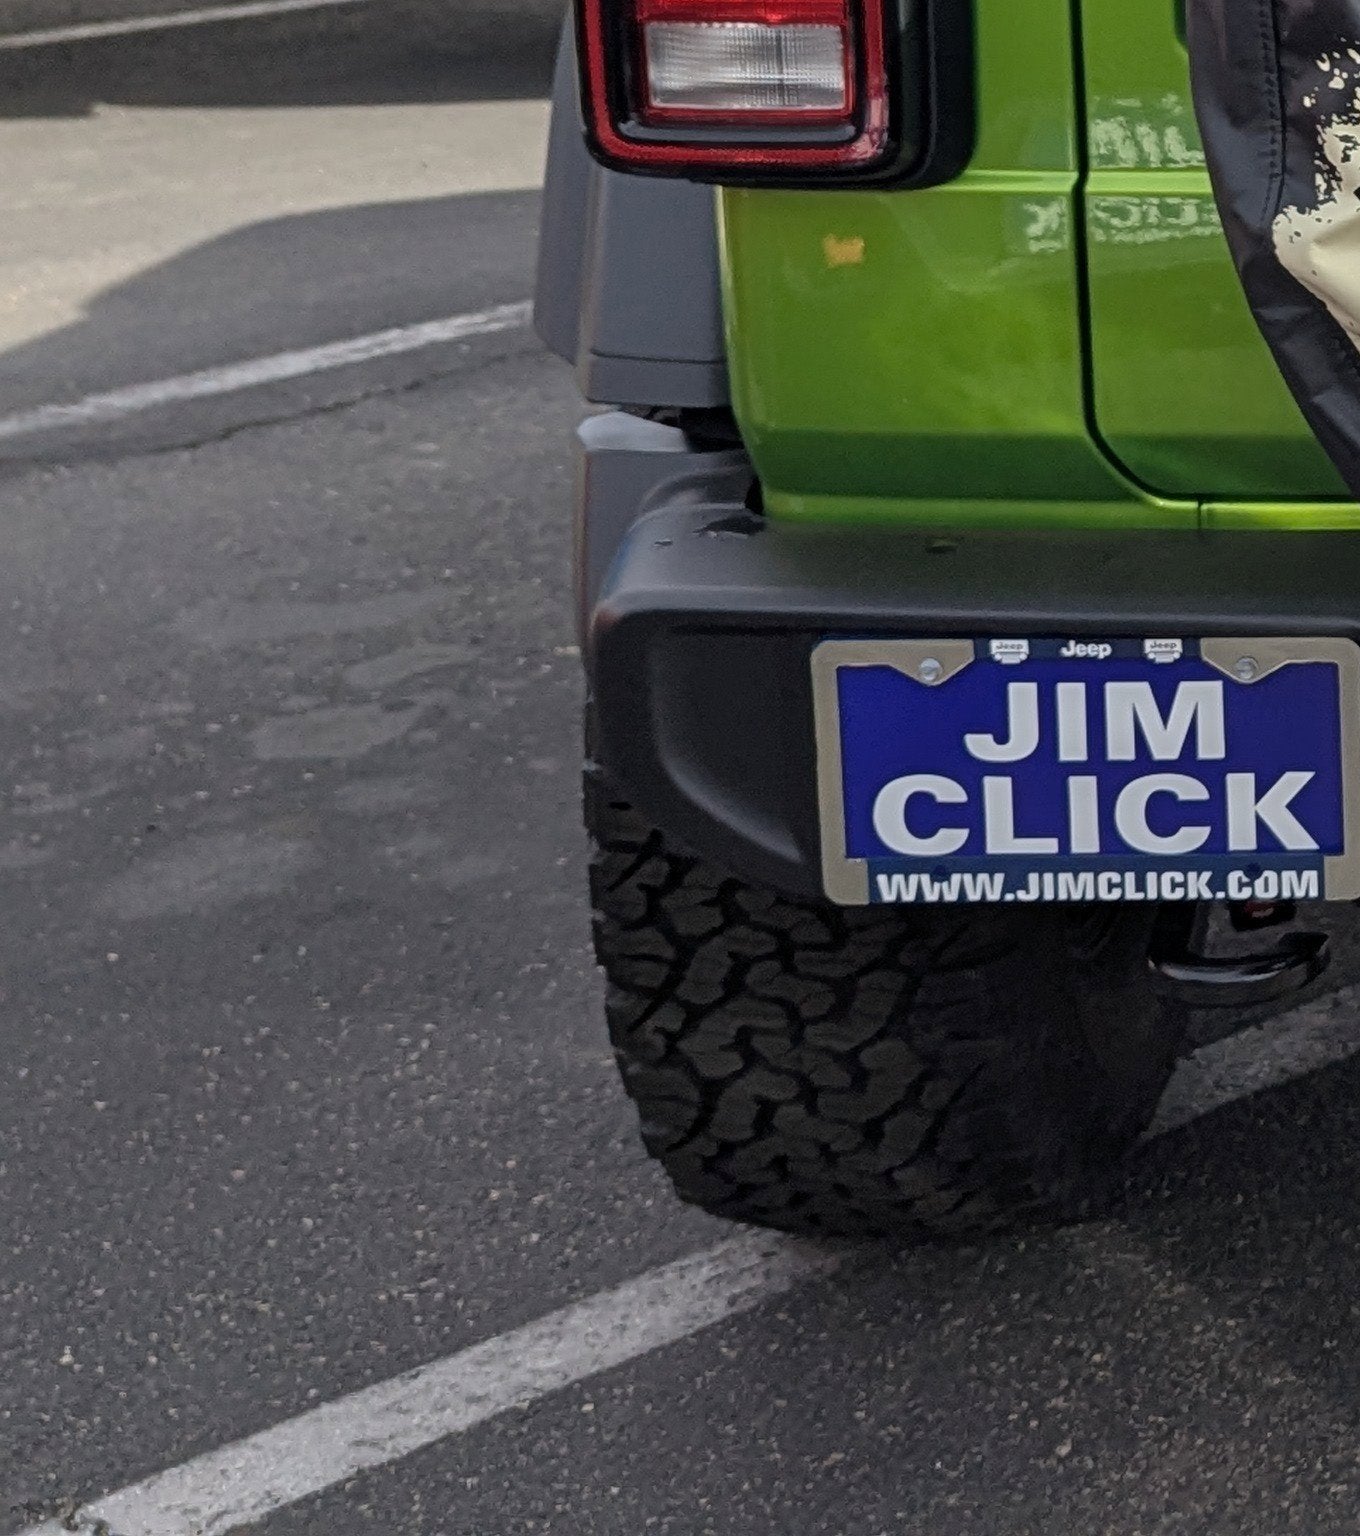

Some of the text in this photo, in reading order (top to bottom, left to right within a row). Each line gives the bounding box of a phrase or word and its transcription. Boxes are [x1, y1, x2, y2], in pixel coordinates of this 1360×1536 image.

[1061, 639, 1112, 659] Jeep
[963, 680, 1226, 763] JIM
[872, 771, 1320, 856] CLICK
[876, 870, 1318, 902] WWW.JIMCLICK.COM
